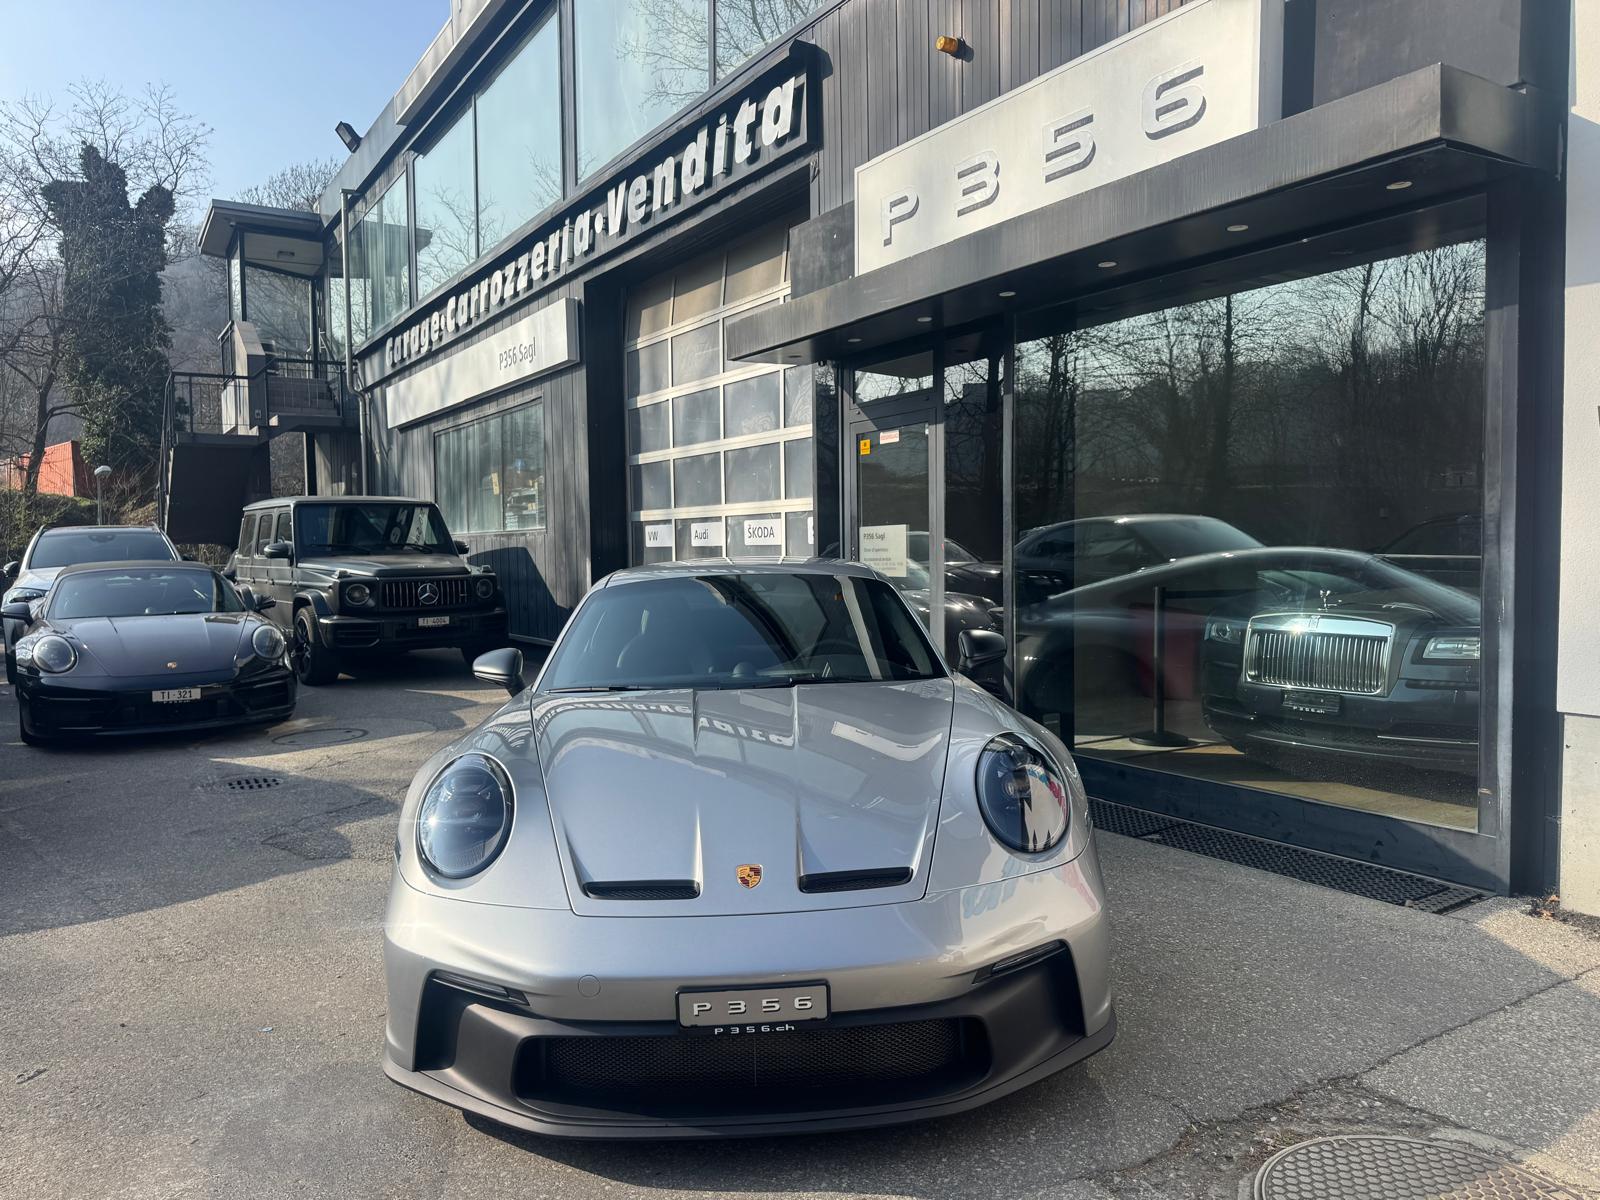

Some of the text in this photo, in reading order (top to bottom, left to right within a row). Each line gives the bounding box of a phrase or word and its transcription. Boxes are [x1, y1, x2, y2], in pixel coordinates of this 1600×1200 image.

[499, 336, 536, 371] P356 Sagl
[648, 530, 659, 542] VW
[694, 528, 709, 540] Audi
[747, 524, 775, 539] ŠKODA
